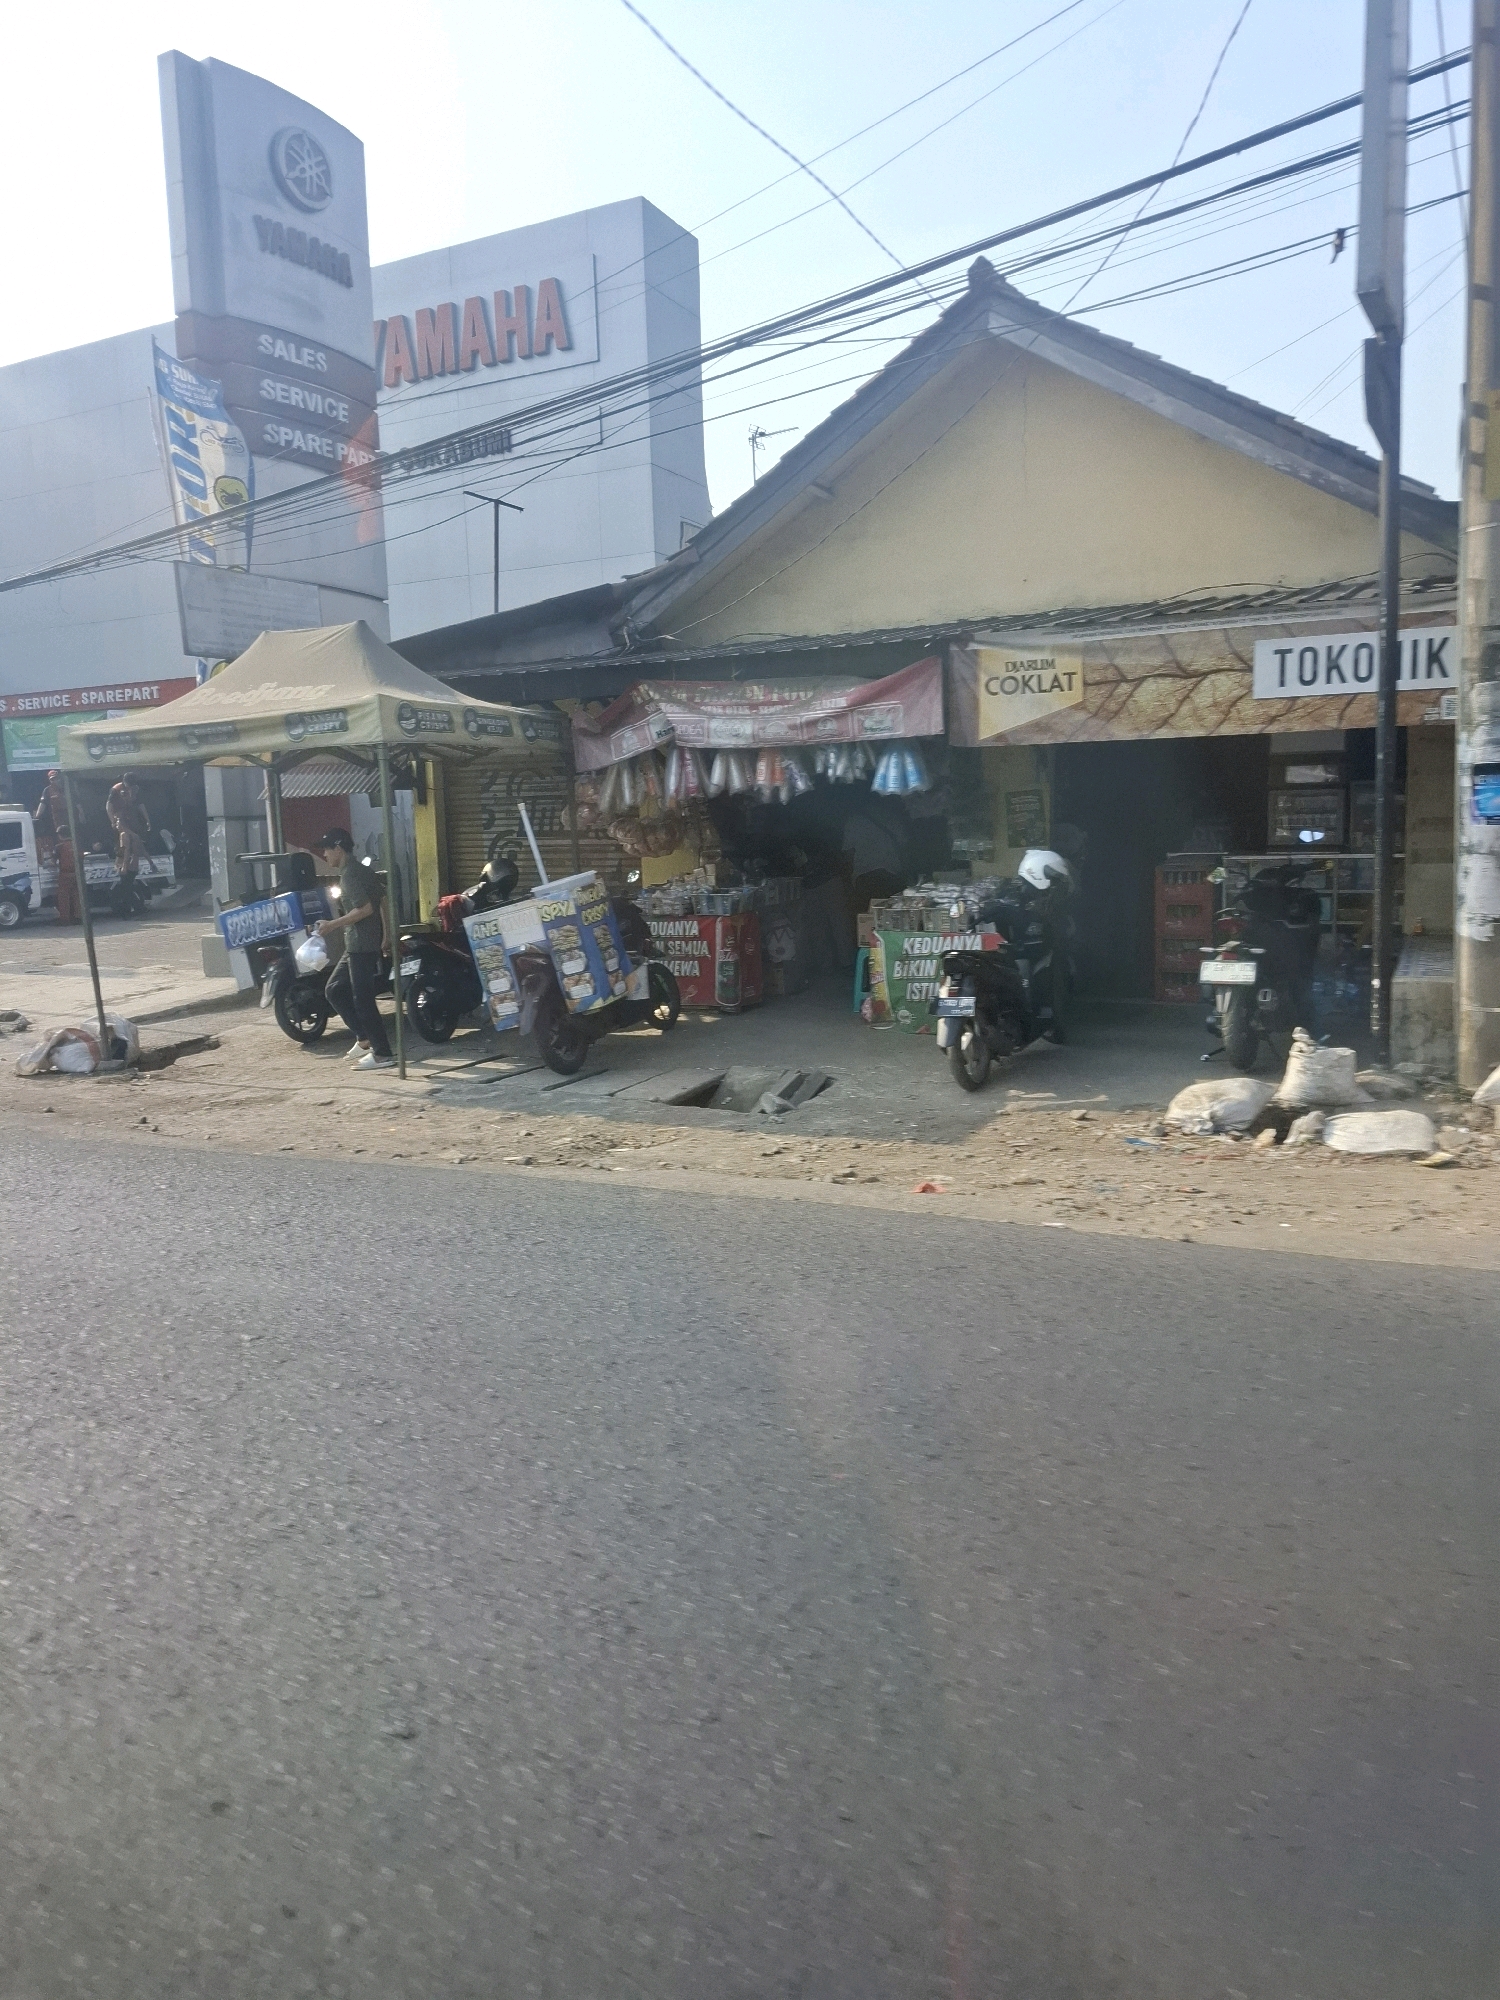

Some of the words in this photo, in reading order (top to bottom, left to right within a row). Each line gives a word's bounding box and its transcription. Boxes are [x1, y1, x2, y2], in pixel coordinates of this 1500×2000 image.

[257, 334, 327, 373] SALES
[260, 379, 349, 423] SERVICE
[263, 423, 334, 459] SPARE
[1005, 658, 1057, 673] DJARUM
[1273, 642, 1375, 688] TOKO
[984, 671, 1078, 697] COKLAT
[668, 940, 710, 957] SEMUA
[902, 934, 983, 956] KEDUANYA
